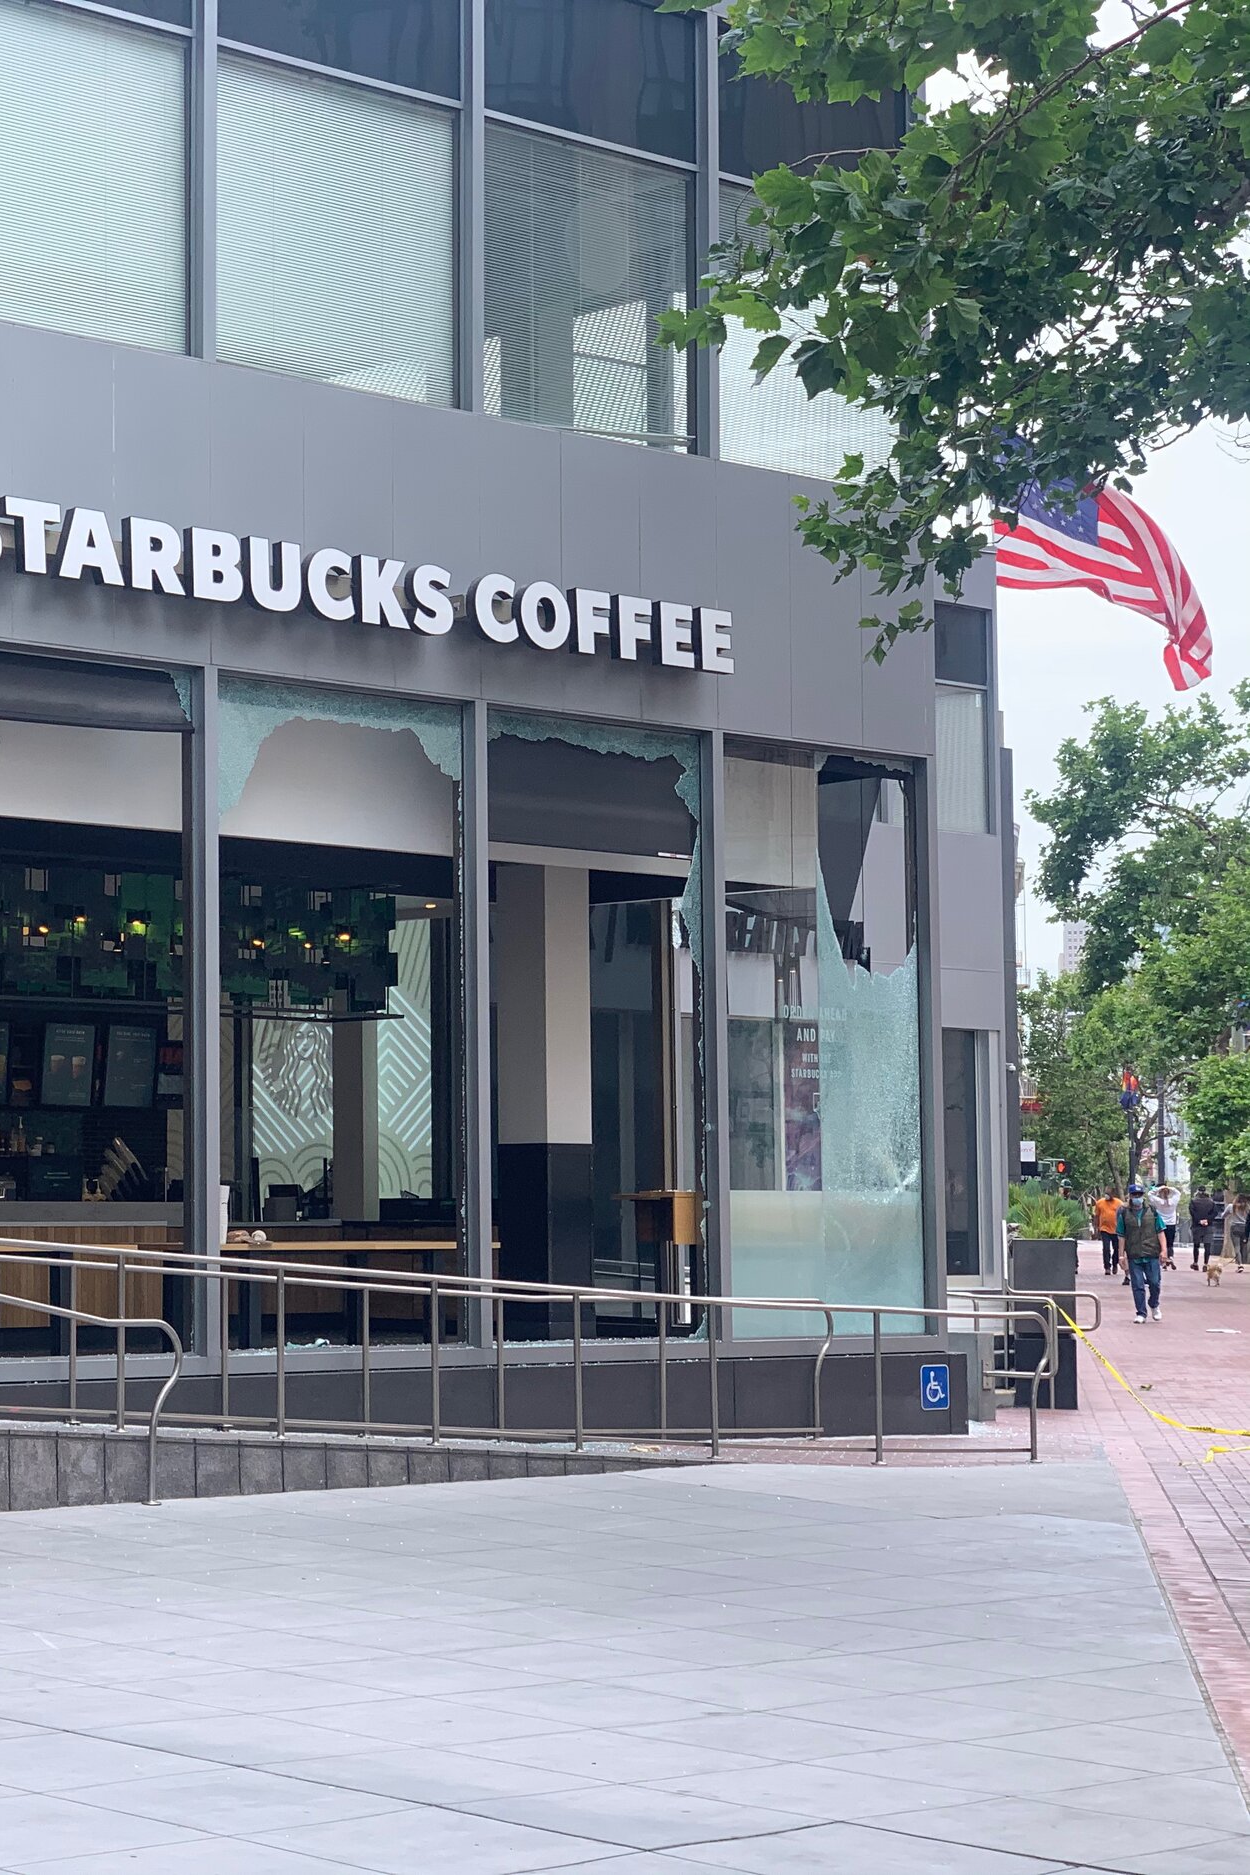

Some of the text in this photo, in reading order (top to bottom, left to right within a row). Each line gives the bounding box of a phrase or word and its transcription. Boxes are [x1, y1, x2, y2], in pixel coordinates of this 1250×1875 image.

[469, 572, 735, 675] COFFEE
[796, 1027, 817, 1042] AND
[801, 1052, 819, 1063] WITH
